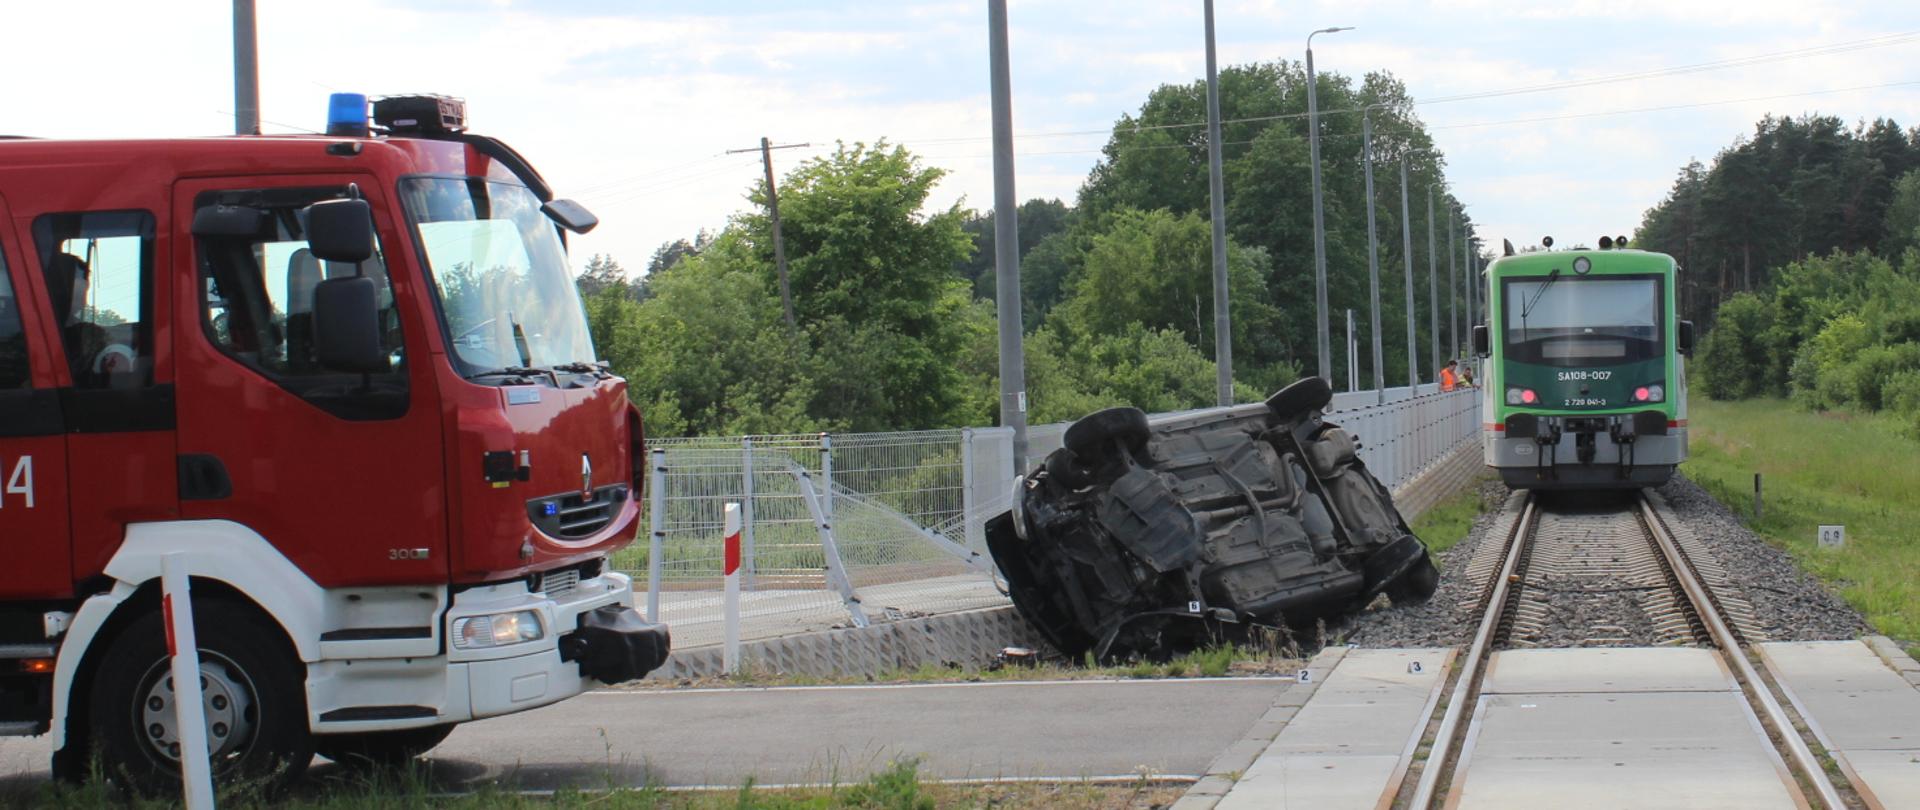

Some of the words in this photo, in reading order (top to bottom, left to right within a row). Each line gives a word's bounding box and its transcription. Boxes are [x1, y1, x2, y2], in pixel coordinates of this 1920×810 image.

[1557, 370, 1612, 381] SA108-007
[1412, 661, 1422, 672] 3
[1300, 670, 1309, 681] 2
